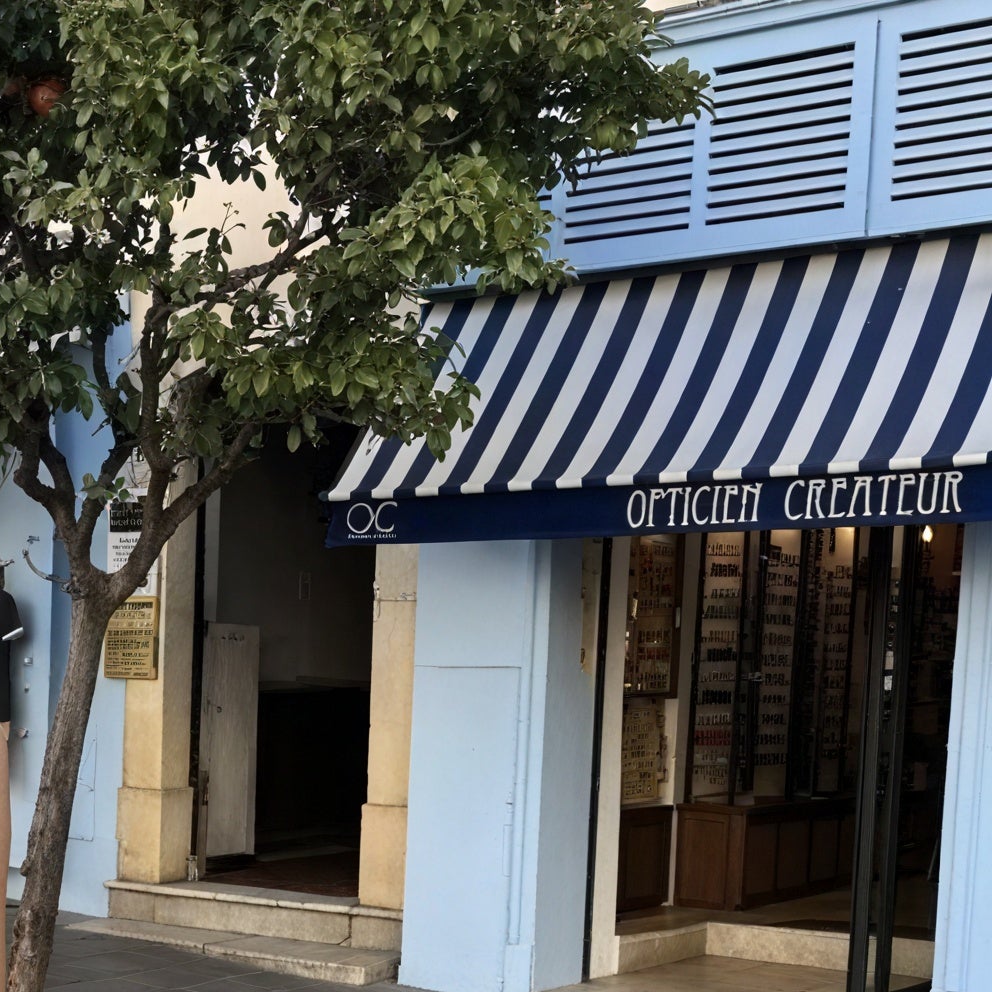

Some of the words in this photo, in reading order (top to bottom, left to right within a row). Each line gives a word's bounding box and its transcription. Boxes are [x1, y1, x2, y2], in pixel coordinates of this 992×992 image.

[346, 501, 398, 534] OC
[626, 482, 763, 528] OPTICIEN
[784, 471, 963, 521] CREATEUR
